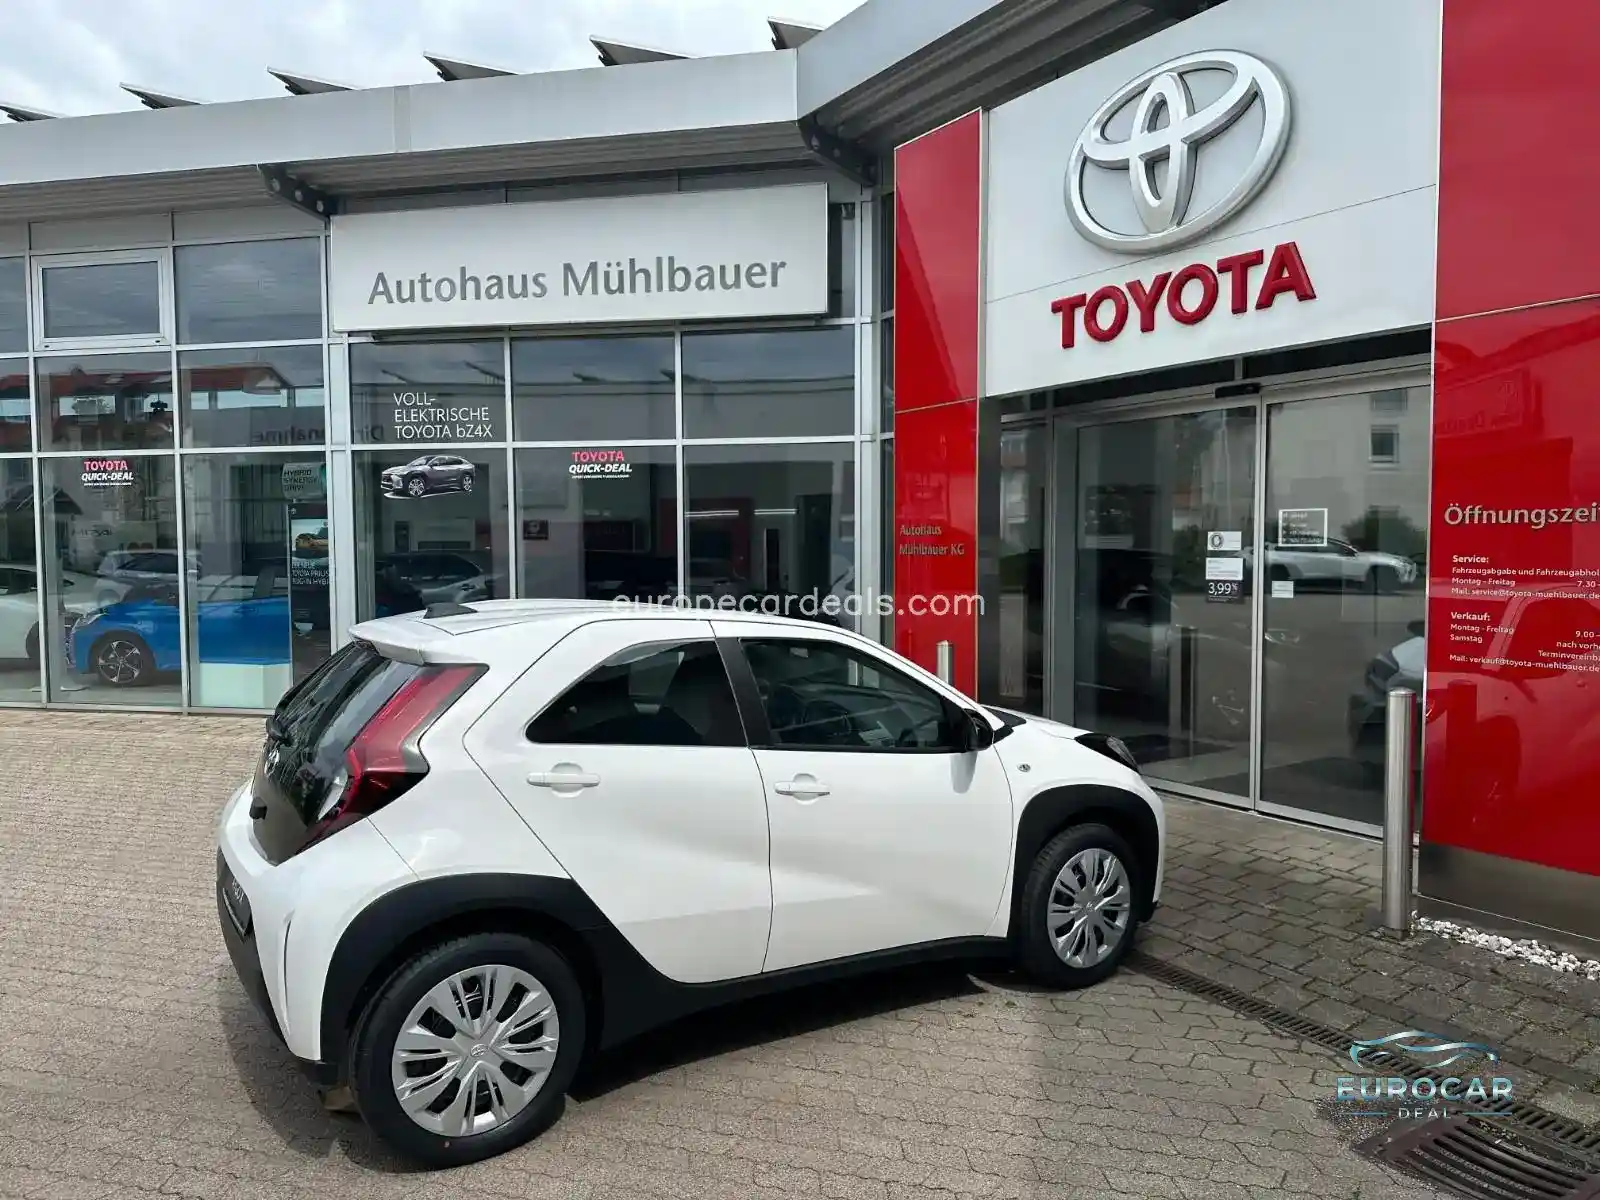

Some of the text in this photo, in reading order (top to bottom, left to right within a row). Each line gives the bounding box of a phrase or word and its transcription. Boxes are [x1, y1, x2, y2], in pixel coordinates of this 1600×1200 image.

[368, 256, 788, 305] Autohaus Mühlbauer
[1051, 241, 1317, 349] TOYOTA
[393, 391, 437, 407] VOLL-
[394, 407, 490, 423] ELEKTRISCHE
[394, 423, 493, 439] TOYOTA bZ4X
[571, 450, 625, 463] TOYOTA
[83, 460, 128, 471] TOYOTA
[568, 463, 633, 475] QUICK-DEAL
[81, 472, 134, 482] QUICK-DEAL
[1444, 502, 1600, 530] Öffnungszei
[900, 524, 942, 536] Autohaus
[899, 541, 965, 555] Mühlbauer KG
[1452, 554, 1489, 563] Service:
[1452, 566, 1517, 576] Fahrzeugabgabe
[1451, 577, 1481, 586] Montag
[1488, 578, 1516, 587] Freitag
[1577, 580, 1596, 588] 7.30
[1450, 611, 1491, 621] Verkauf:
[1450, 623, 1480, 633] Montag
[1486, 625, 1514, 635] Freitag
[1575, 630, 1595, 638] 9.00
[1450, 633, 1483, 643] Samstag
[1556, 641, 1577, 649] nach
[1449, 654, 1468, 662] Mail:
